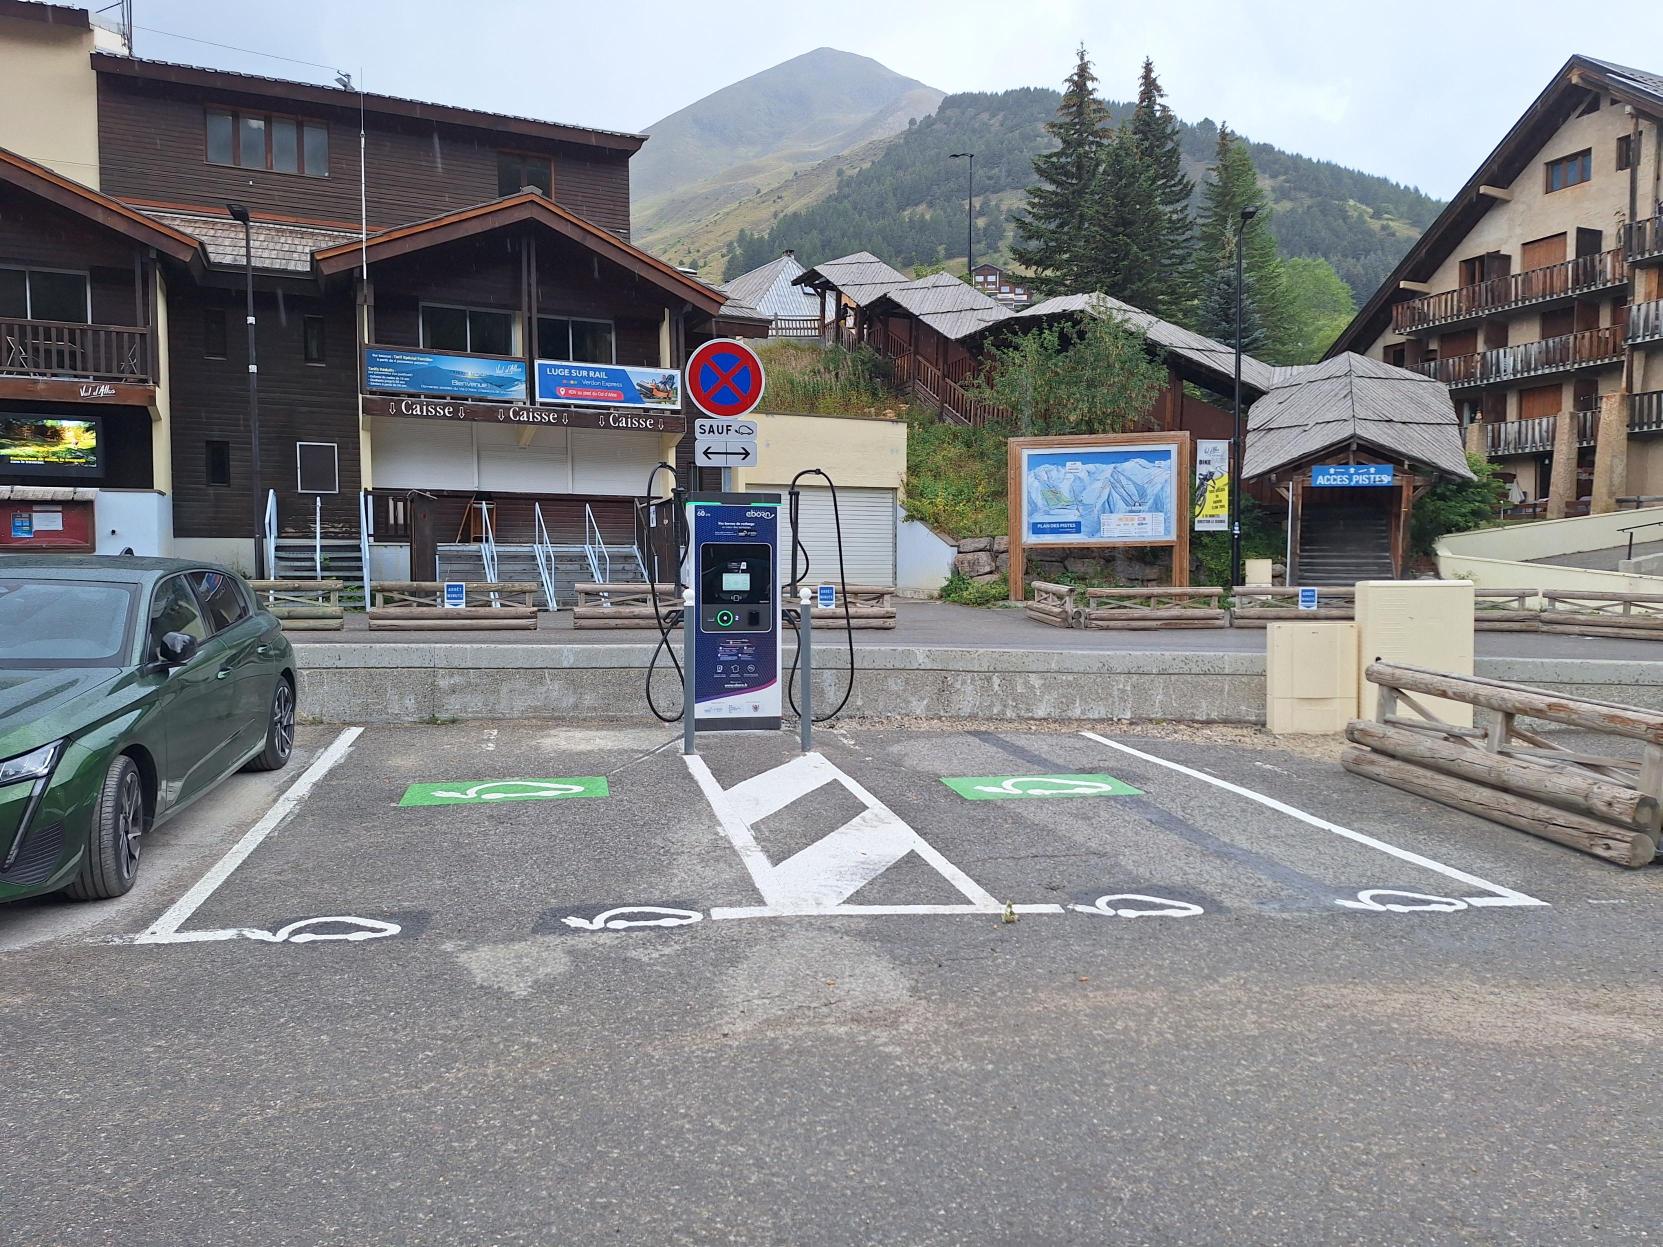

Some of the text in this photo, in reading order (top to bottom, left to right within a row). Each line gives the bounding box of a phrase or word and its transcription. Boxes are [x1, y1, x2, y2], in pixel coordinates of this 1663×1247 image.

[546, 368, 570, 376] LUGE
[401, 400, 454, 417] Caisse
[509, 406, 558, 423] Caisse
[609, 413, 654, 429] Caisse
[699, 424, 732, 435] SAUF
[1317, 475, 1388, 485] ACCES PISTES
